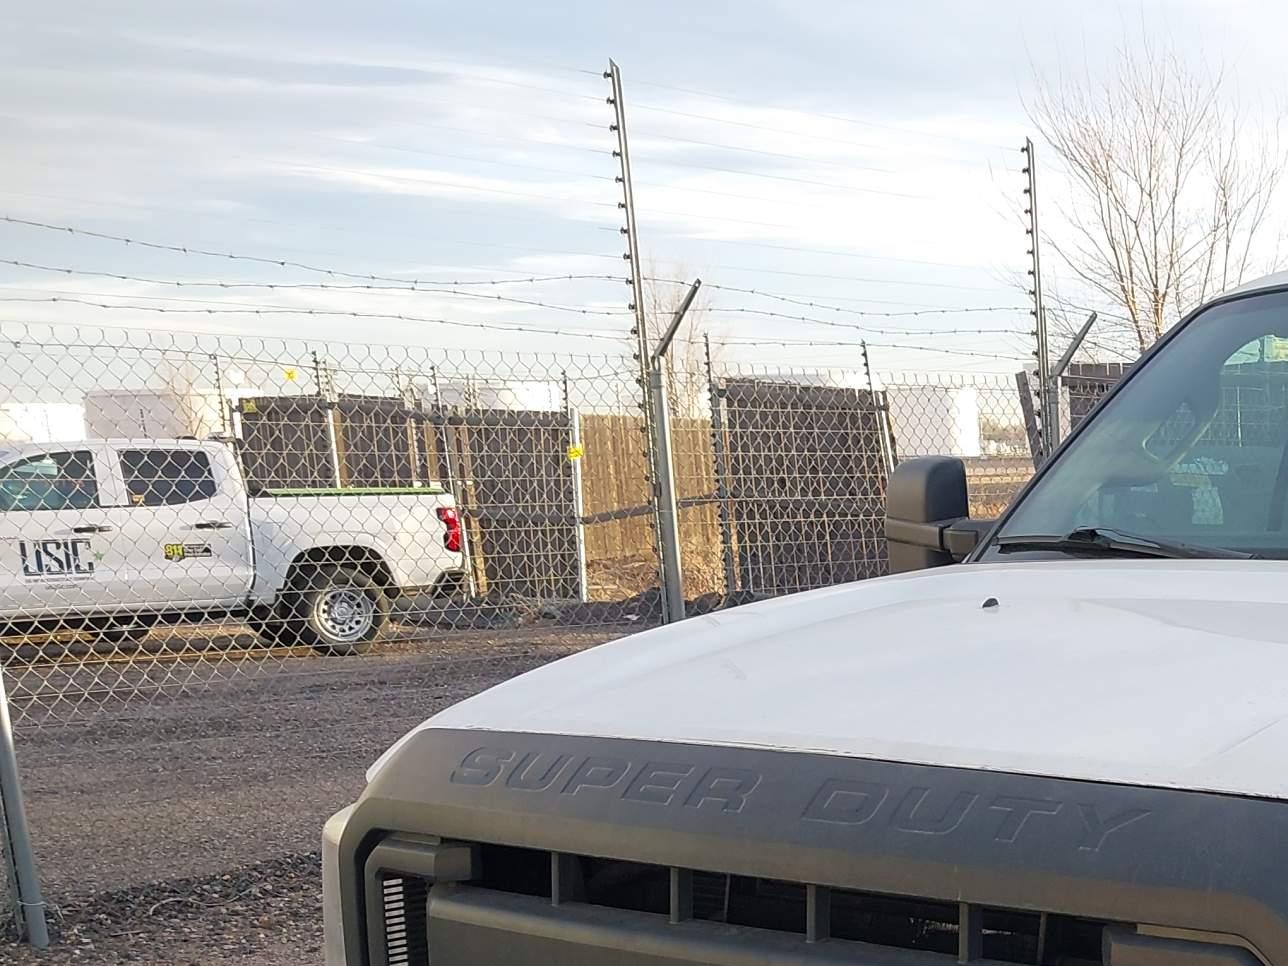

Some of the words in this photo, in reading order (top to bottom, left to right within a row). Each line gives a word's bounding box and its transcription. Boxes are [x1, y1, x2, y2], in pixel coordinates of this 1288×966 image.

[18, 537, 96, 577] USIC
[449, 745, 764, 814] SUPER
[799, 777, 1151, 852] DUTY
